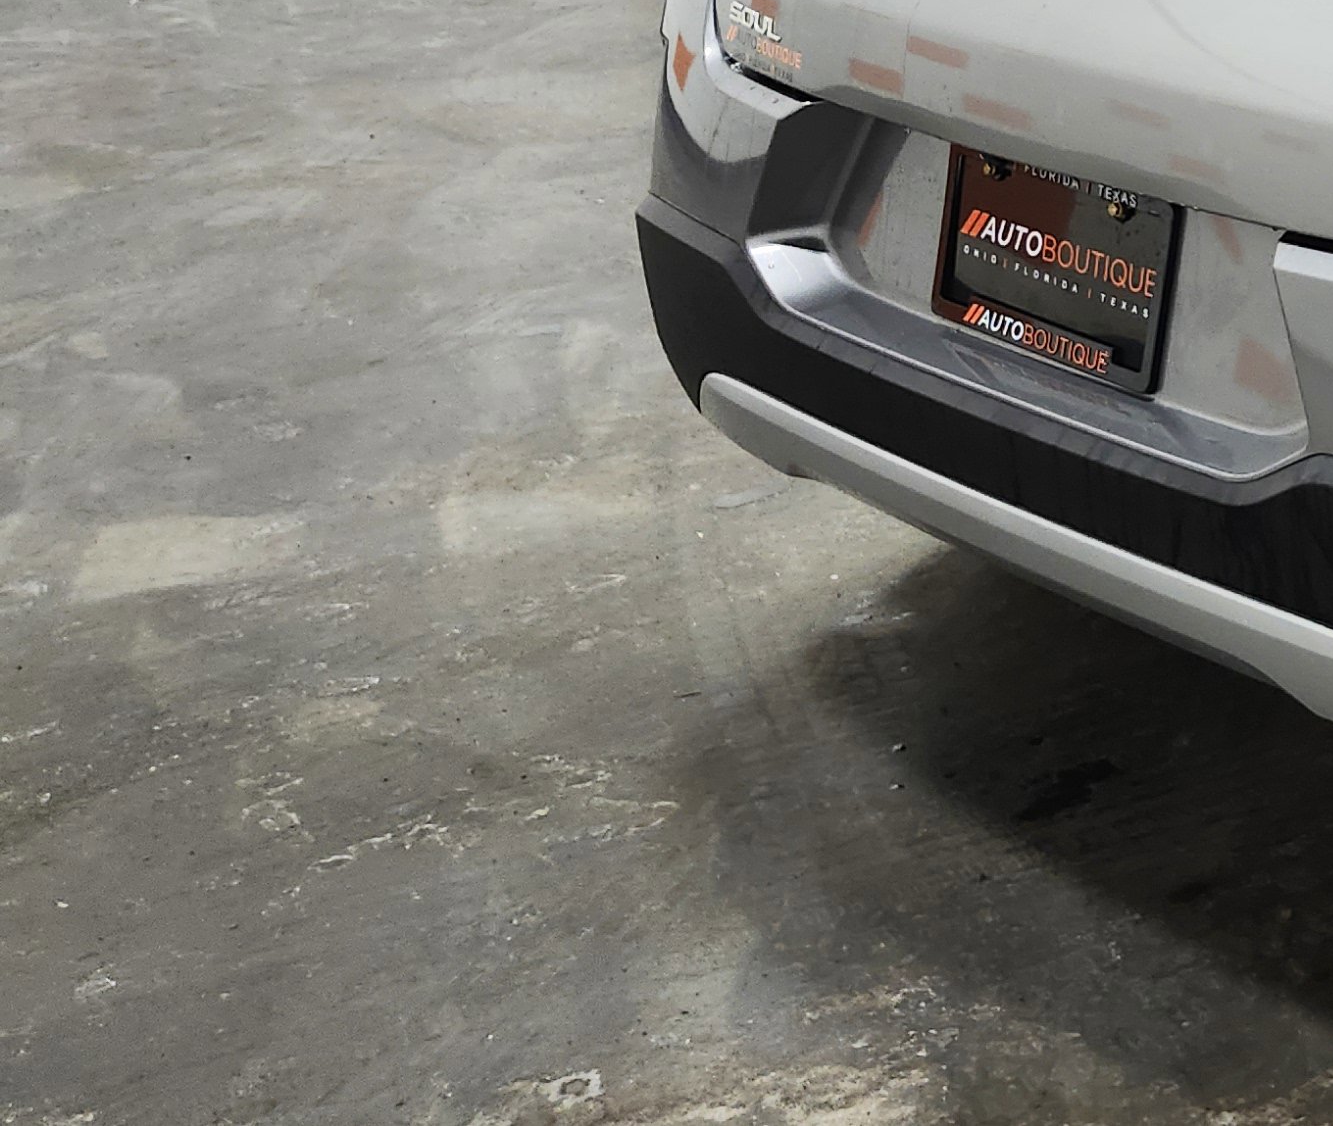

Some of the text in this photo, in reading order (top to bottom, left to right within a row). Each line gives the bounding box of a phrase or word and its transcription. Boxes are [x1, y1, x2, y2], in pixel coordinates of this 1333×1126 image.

[729, 0, 782, 42] SOUL
[1098, 184, 1137, 208] TEXAS
[963, 244, 1150, 319] OHIO FLORIDA TEXAS
[980, 216, 1157, 298] AUTOBOUTIQUE
[978, 309, 1110, 374] AUTOBOUTIQUE
